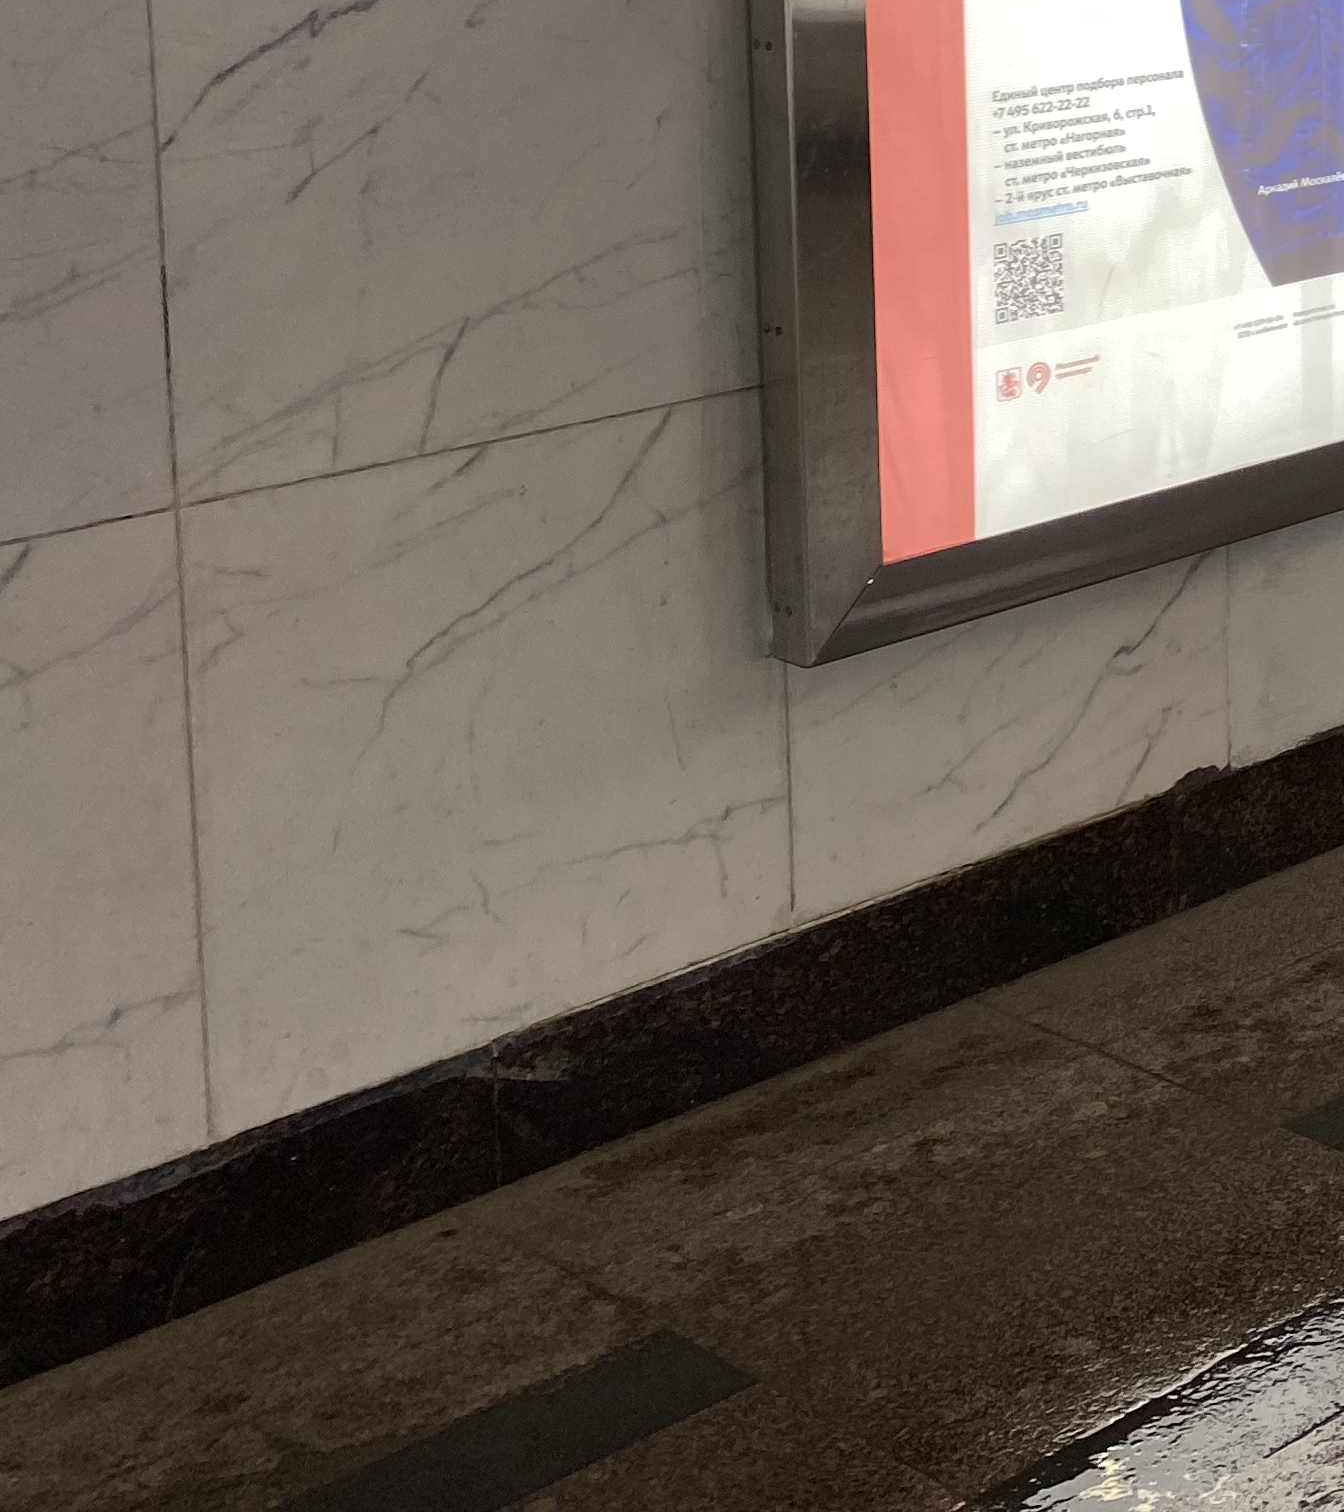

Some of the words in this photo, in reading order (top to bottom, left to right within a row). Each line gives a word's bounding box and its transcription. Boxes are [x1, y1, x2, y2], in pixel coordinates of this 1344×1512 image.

[992, 87, 1037, 103] Единый
[1040, 83, 1074, 98] центр
[1077, 77, 1124, 93] подбора
[1127, 70, 1184, 87] персонала
[1007, 103, 1029, 117] 495
[1020, 136, 1057, 153] метро
[1005, 150, 1064, 170] наземный
[1021, 170, 1058, 188] метро
[1072, 179, 1108, 197] метро
